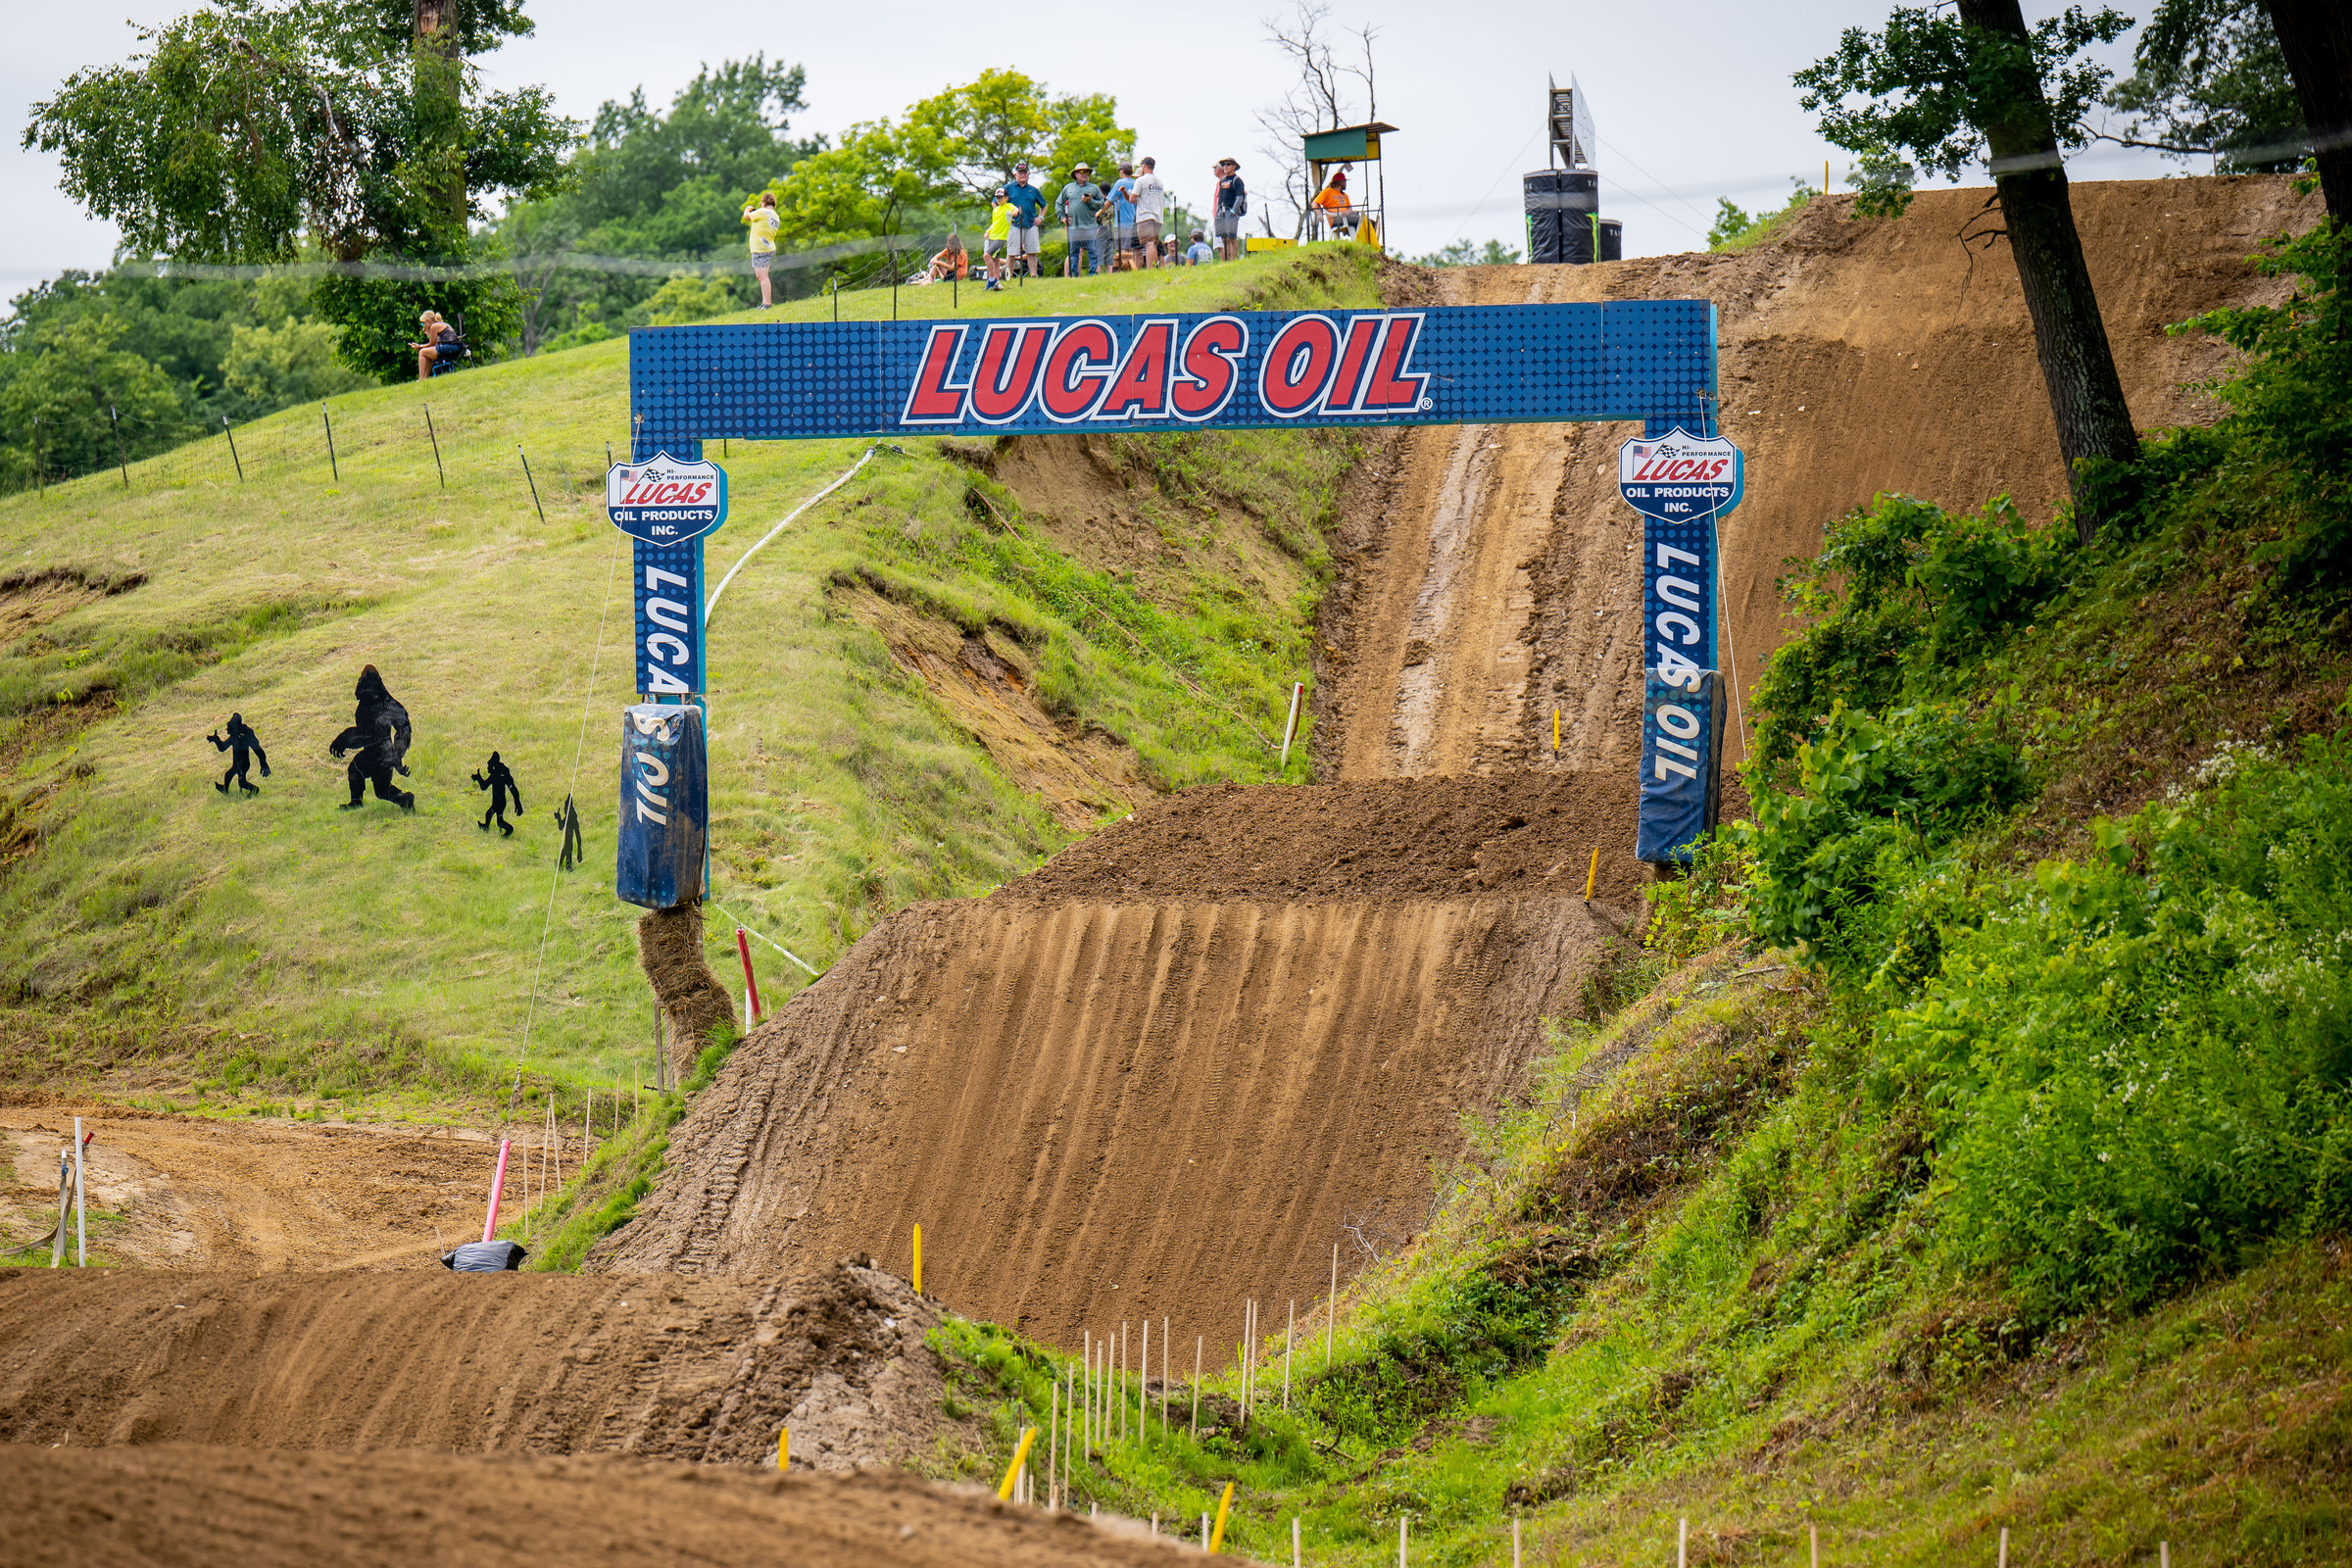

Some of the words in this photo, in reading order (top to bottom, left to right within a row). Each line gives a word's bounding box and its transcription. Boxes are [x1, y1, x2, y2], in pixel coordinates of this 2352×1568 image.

[900, 315, 1249, 425] LUCAS
[1633, 459, 1729, 481] LUCAS
[619, 482, 712, 505] LUCAS
[1626, 487, 1650, 498] OIL
[1654, 487, 1729, 498] PRODUCTS
[613, 512, 637, 521] OIL
[641, 510, 713, 521] PRODUCTS
[1664, 502, 1692, 513] INC.
[651, 525, 679, 536] INC.
[1655, 542, 1701, 693] LUCAS
[1654, 704, 1701, 781] OIL
[635, 751, 670, 826] OIL
